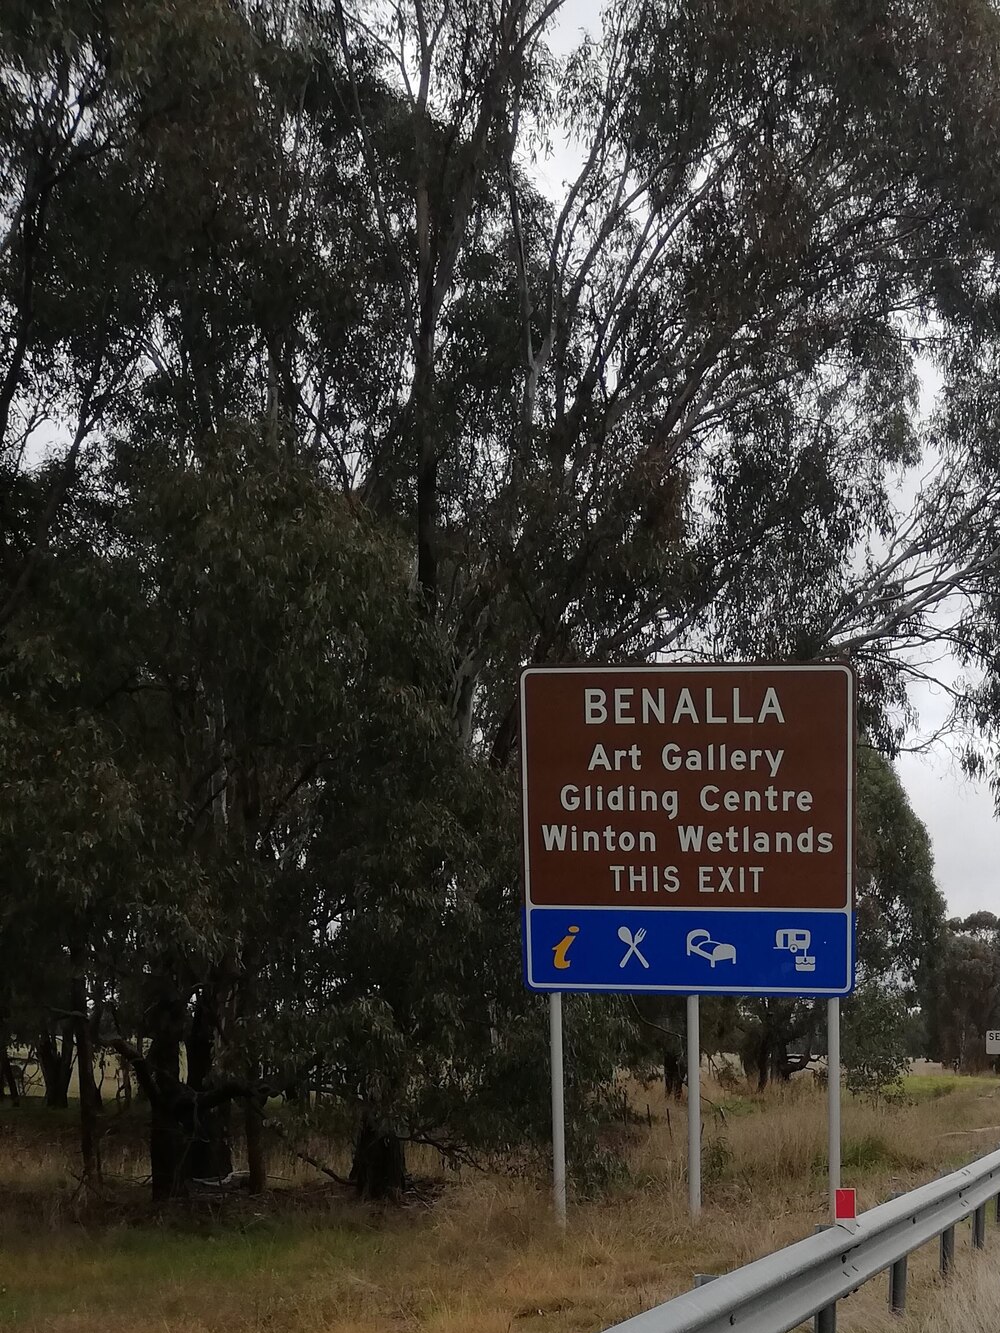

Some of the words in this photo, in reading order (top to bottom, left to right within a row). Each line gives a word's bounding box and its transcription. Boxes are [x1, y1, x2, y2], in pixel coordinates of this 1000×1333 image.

[584, 687, 785, 725] BENALLA
[588, 744, 642, 771] Art
[661, 743, 785, 777] Gallery
[560, 784, 679, 820] Gliding
[699, 785, 814, 812] Centre
[541, 824, 657, 852] Winton
[677, 825, 834, 853] Wetlands
[609, 865, 680, 892] THIS
[698, 866, 765, 893] EXIT
